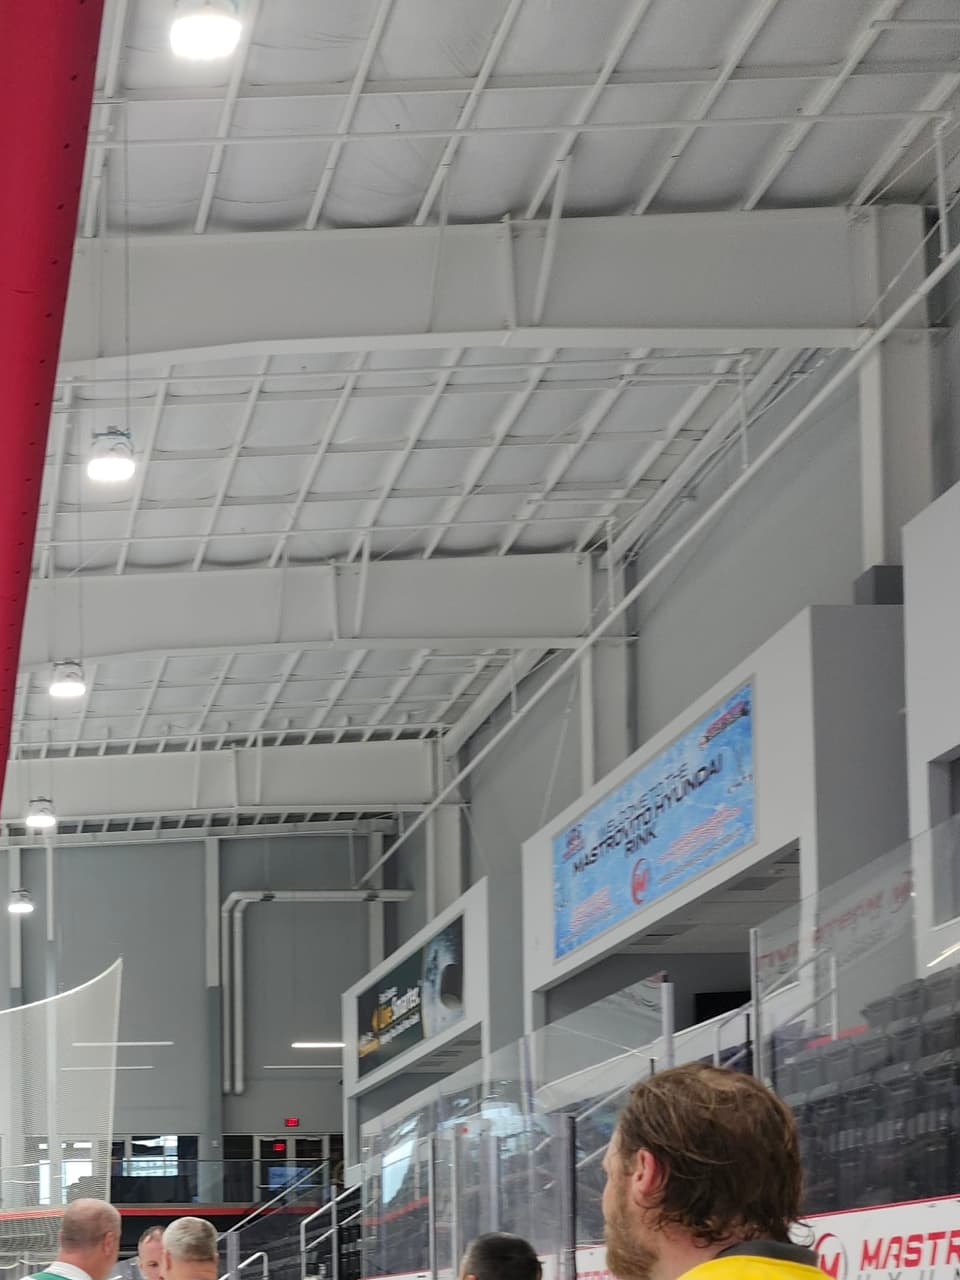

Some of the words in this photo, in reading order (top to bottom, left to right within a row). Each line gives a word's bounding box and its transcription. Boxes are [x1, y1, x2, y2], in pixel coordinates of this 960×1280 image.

[573, 811, 651, 874] MASTROVITO
[655, 754, 722, 815] HYUNDAI
[625, 829, 658, 859] RINK
